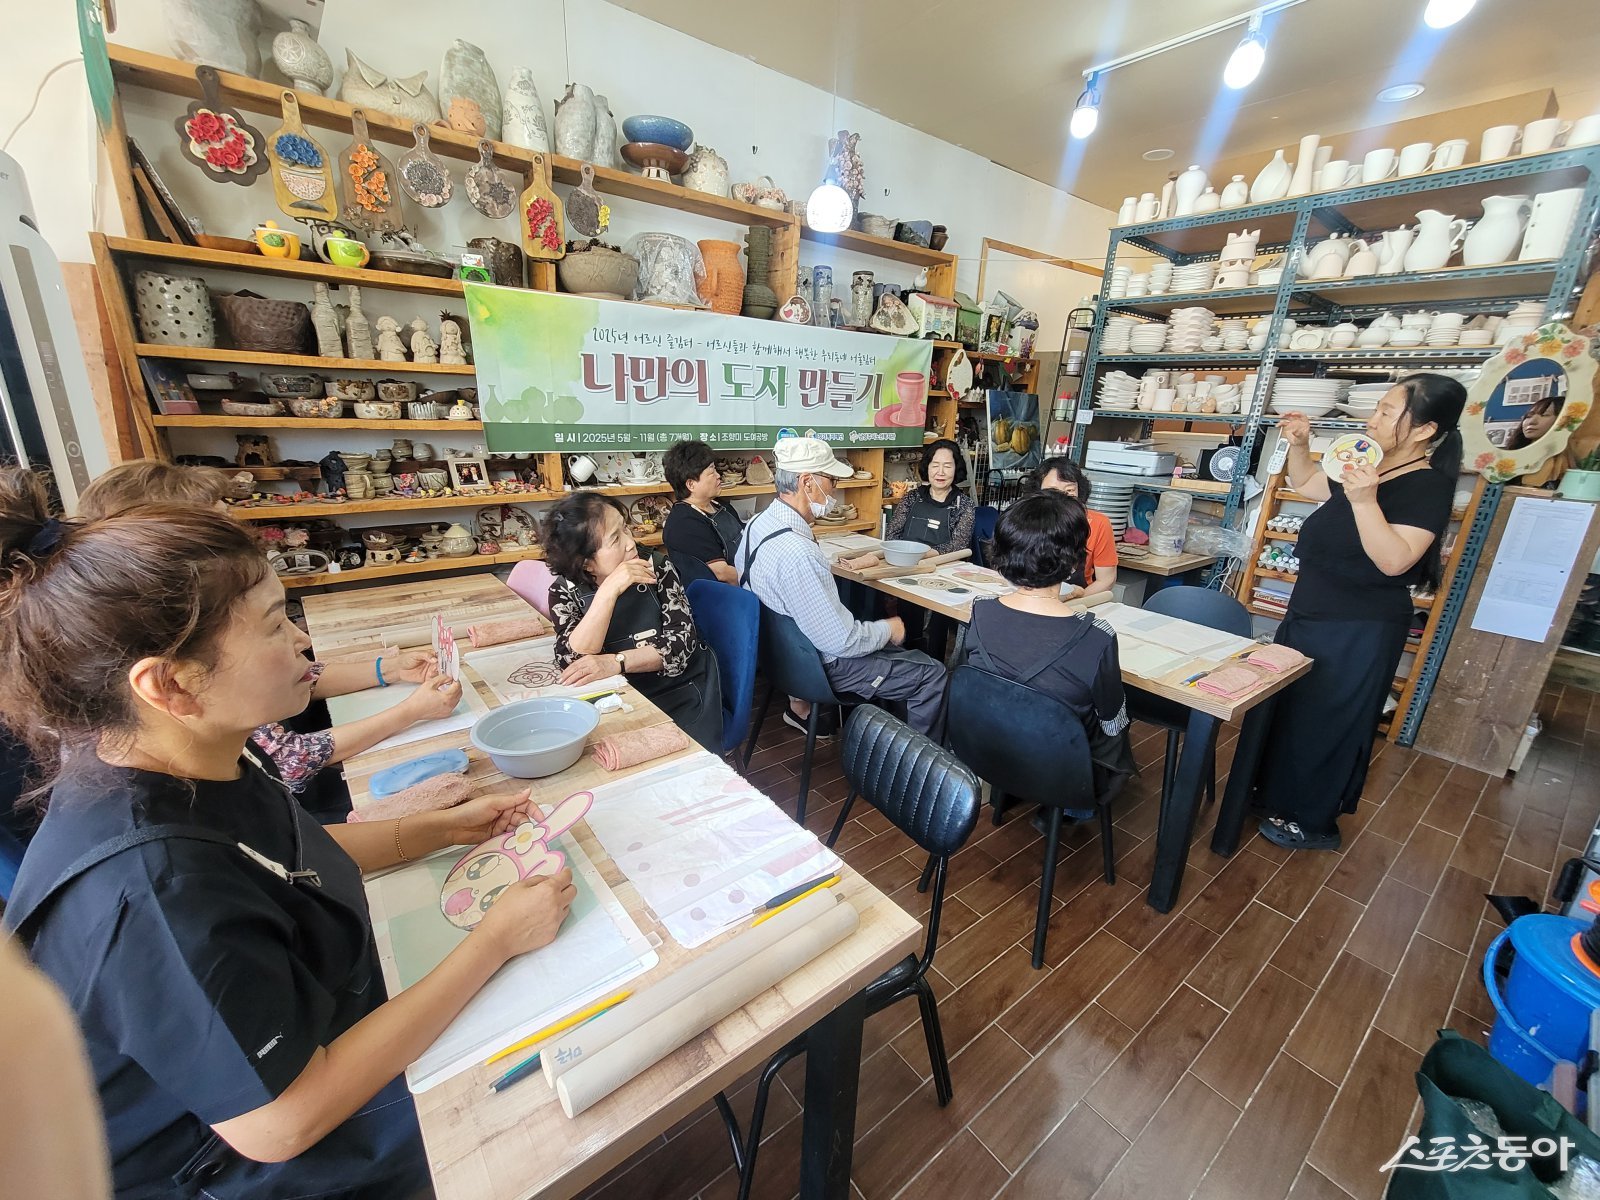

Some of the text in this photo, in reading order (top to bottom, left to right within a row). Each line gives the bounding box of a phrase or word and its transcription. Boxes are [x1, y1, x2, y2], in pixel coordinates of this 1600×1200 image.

[592, 327, 628, 344] 2025년
[634, 332, 662, 348] 어르신
[706, 339, 747, 355] 어르신들과
[752, 341, 791, 357] 함께해서
[794, 347, 818, 360] 행복한
[821, 349, 847, 363] 우리동네
[850, 352, 876, 366] 어울림터
[580, 352, 884, 411] 나만의 도자 만들기
[554, 432, 564, 443] 일
[582, 432, 616, 443] 2025년
[617, 432, 631, 443] 5월
[639, 432, 655, 443] 11월
